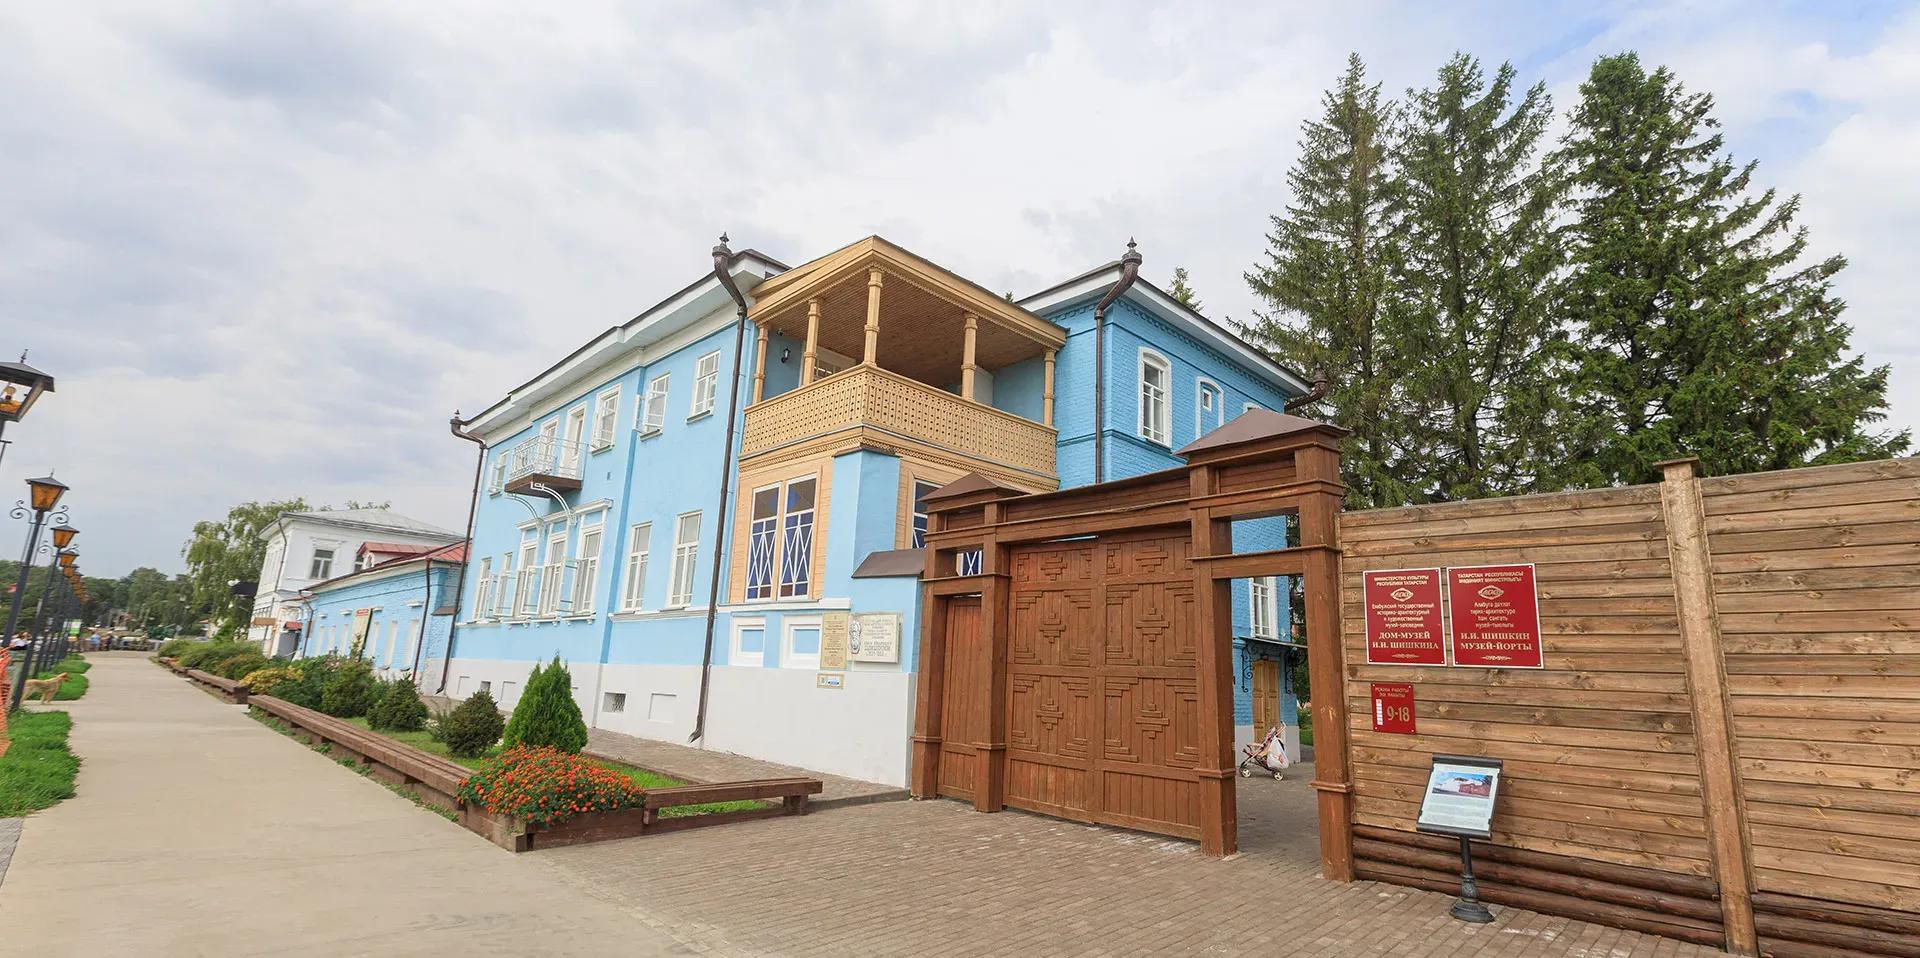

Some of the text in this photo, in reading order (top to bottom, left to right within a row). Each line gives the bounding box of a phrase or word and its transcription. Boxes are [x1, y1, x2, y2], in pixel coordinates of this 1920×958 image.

[1379, 631, 1430, 639] ДОМ-МУЗЕЙ
[1461, 642, 1533, 650] МУЗЕЙ-ЙОРТЫ
[1387, 706, 1410, 722] 9-18
